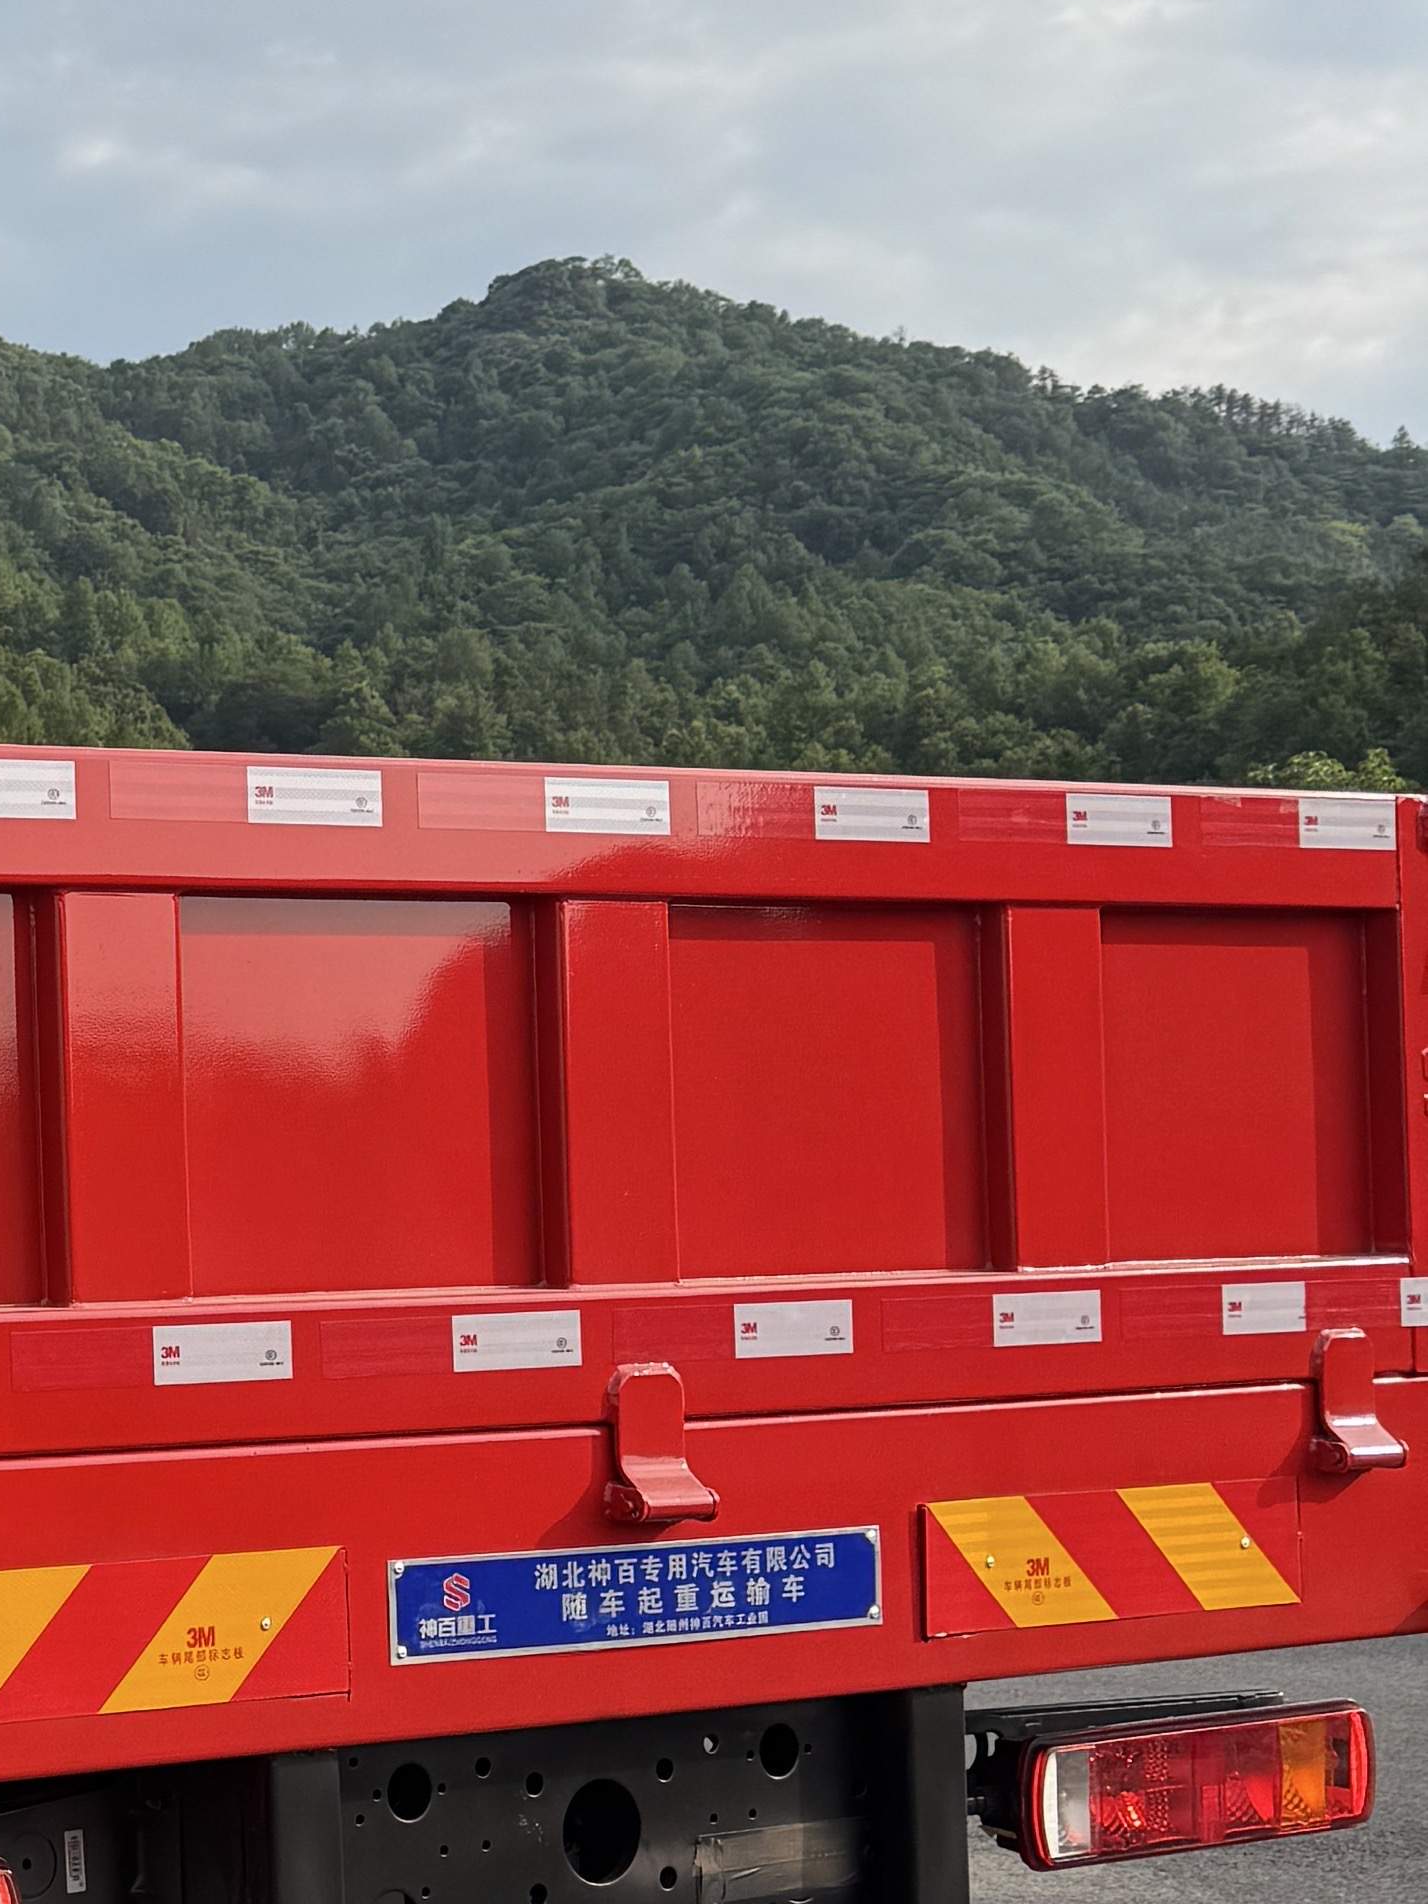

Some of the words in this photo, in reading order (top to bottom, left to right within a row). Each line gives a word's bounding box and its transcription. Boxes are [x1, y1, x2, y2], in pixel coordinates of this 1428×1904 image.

[254, 786, 274, 798] 3M
[551, 796, 570, 808] 3M
[820, 805, 838, 816] 3M
[999, 1312, 1014, 1323] 3M
[740, 1322, 757, 1334] 3M
[460, 1335, 478, 1347] 3M
[161, 1346, 180, 1359] 3M
[534, 1543, 835, 1591] 湖北神百专用汽车有限公司
[1027, 1557, 1050, 1576] 3M
[562, 1574, 805, 1621] 随车起重运输车
[419, 1614, 498, 1638] 神百重工
[186, 1625, 216, 1648] 3M
